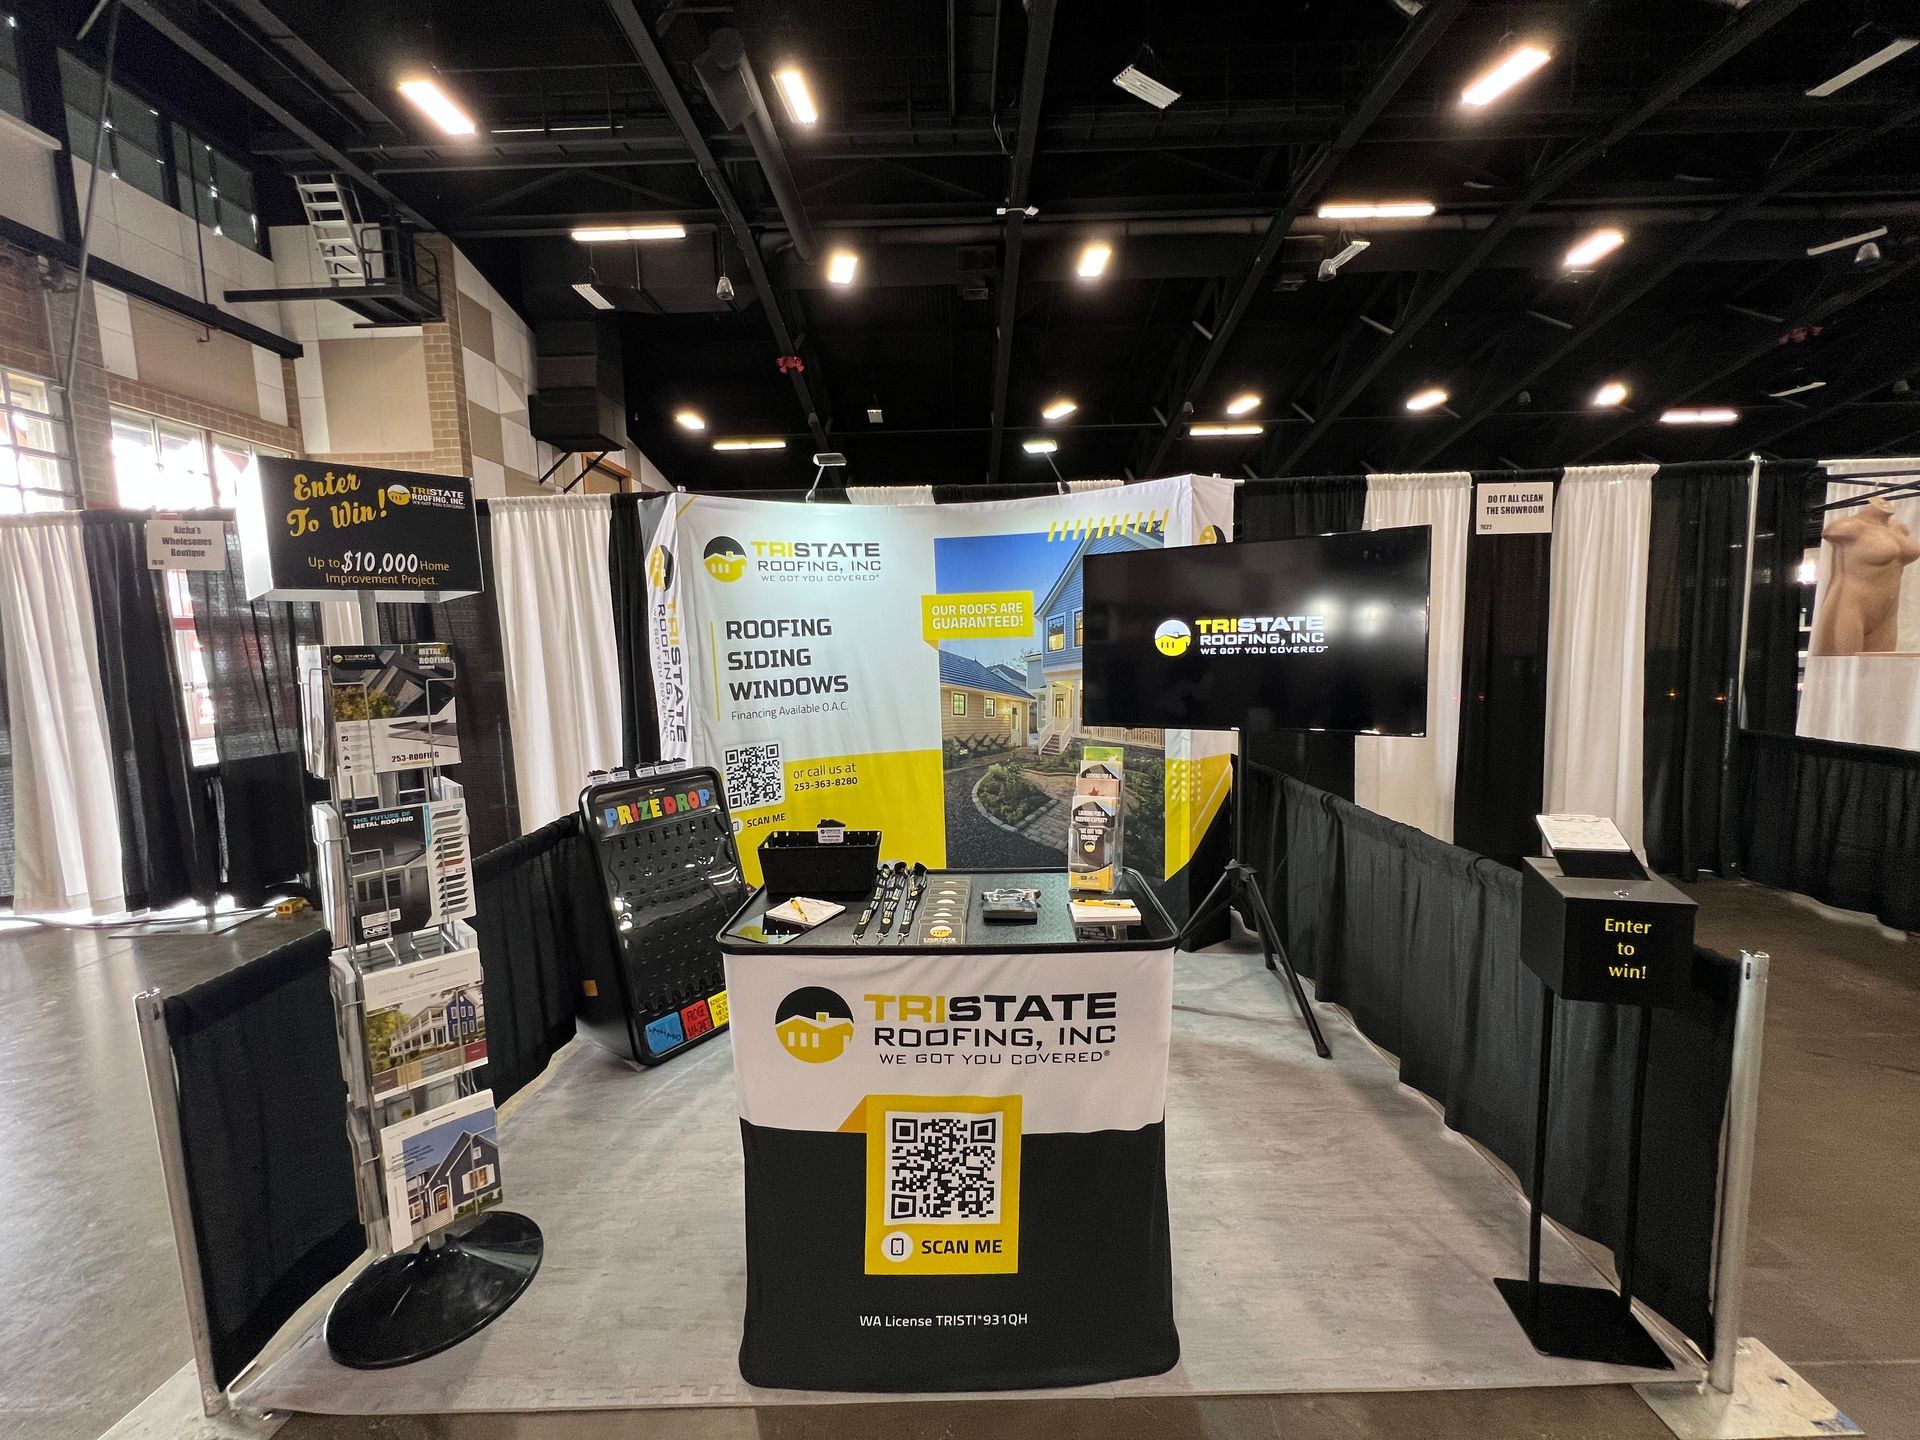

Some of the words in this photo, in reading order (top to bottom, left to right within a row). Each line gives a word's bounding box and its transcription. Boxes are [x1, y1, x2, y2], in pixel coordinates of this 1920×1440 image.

[294, 471, 360, 501] Enter
[410, 486, 464, 499] TRISTATE
[450, 497, 466, 506] INC.
[1488, 495, 1498, 503] DO
[1500, 495, 1506, 503] IT
[1521, 494, 1544, 502] CLEAN
[1486, 506, 1499, 515] THE
[1500, 506, 1544, 514] SHOWROOM
[287, 507, 320, 537] To
[170, 548, 206, 558] Boutique
[750, 541, 880, 558] TRISTATE
[308, 556, 325, 570] Up
[328, 558, 340, 568] to
[340, 550, 418, 574] $10,000
[420, 561, 450, 571] Home
[758, 560, 843, 574] ROOFING,
[851, 560, 882, 572] INC
[326, 573, 398, 586] Improvement
[402, 574, 438, 586] Project.
[932, 605, 956, 616] OUR
[960, 603, 997, 615] ROOFS
[1000, 602, 1023, 613] ARE
[726, 618, 832, 640] ROOFING
[932, 615, 1024, 630] GUARANTEED!
[1195, 616, 1324, 634] TRISTATE
[1200, 634, 1286, 646] ROOFING,
[1291, 632, 1324, 644] INC
[1220, 647, 1242, 655] GOT
[418, 656, 450, 664] ROOFING
[728, 648, 812, 670] SIDING
[658, 604, 674, 700] ROOFING,
[668, 709, 676, 742] INC
[667, 596, 687, 743] TRISTATE
[729, 675, 848, 701] WINDOWS
[732, 708, 777, 720] Financing
[779, 704, 820, 716] Available
[822, 701, 849, 712] O.A.C.
[794, 770, 804, 779] or
[808, 765, 826, 777] call
[829, 766, 842, 774] us
[845, 762, 856, 773] at
[794, 777, 858, 792] 253-363-8280
[604, 798, 662, 828] PRIZE
[663, 788, 710, 814] DROP
[353, 821, 379, 830] METAL
[380, 816, 414, 825] ROOFING
[370, 812, 400, 821] FUTURE
[747, 815, 770, 828] SCAN
[772, 813, 786, 823] ME
[1604, 918, 1652, 934] Enter
[1617, 942, 1635, 956] to
[1609, 964, 1647, 979] win!
[864, 992, 1117, 1024] TRISTATE
[874, 1027, 1042, 1050] ROOFING,
[1059, 1025, 1116, 1046] INC
[879, 1054, 907, 1064] WE
[915, 1054, 954, 1064] GOT
[962, 1053, 1002, 1065] YOU
[921, 1240, 969, 1254] SCAN
[975, 1240, 1003, 1254] ME
[860, 1315, 881, 1326] WA
[885, 1316, 932, 1327] License
